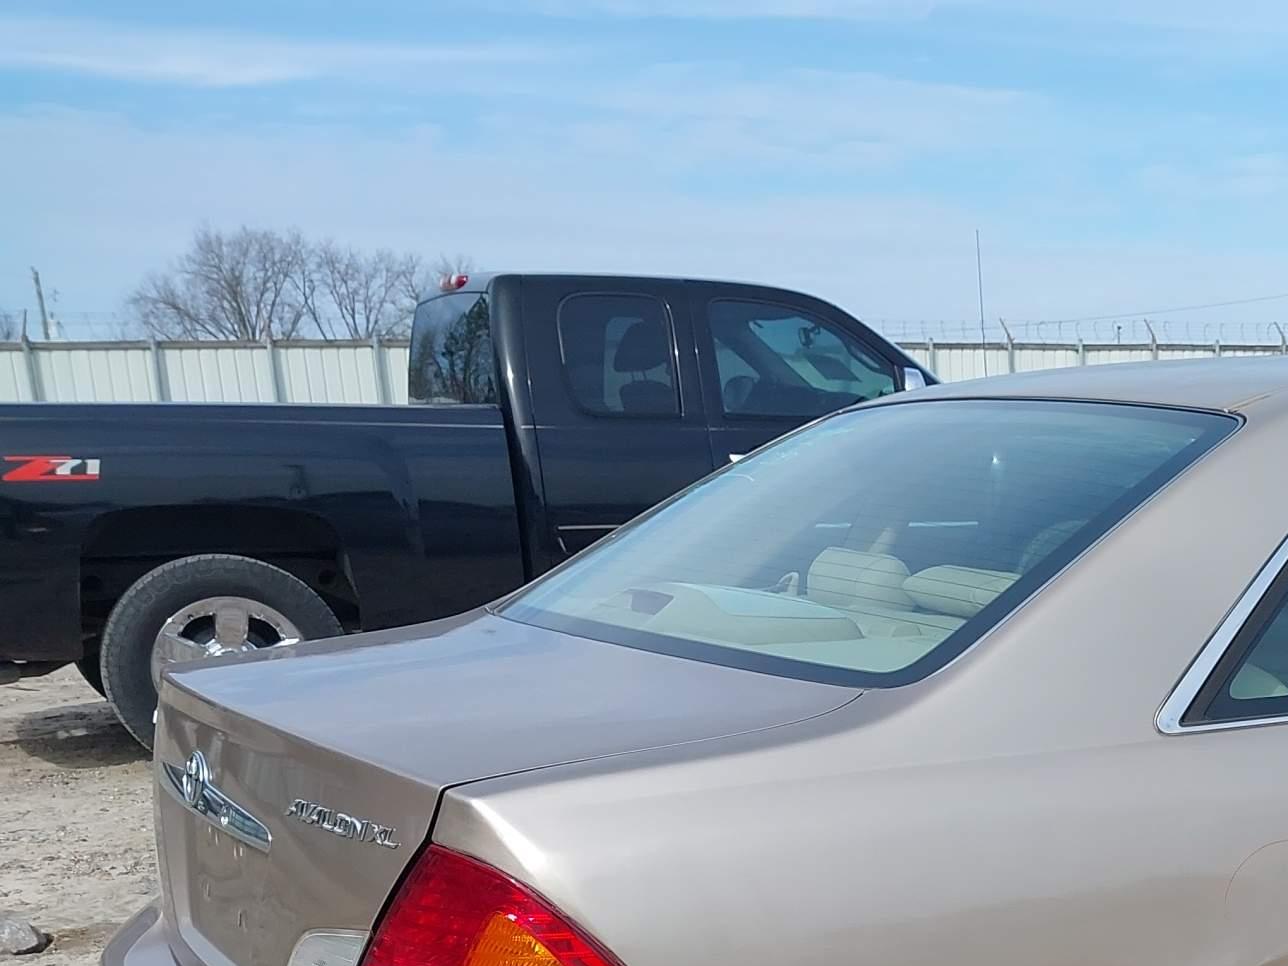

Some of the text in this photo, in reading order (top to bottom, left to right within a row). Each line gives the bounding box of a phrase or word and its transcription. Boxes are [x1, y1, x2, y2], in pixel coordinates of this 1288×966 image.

[2, 455, 101, 481] Z71
[284, 798, 402, 850] AVALON XL
